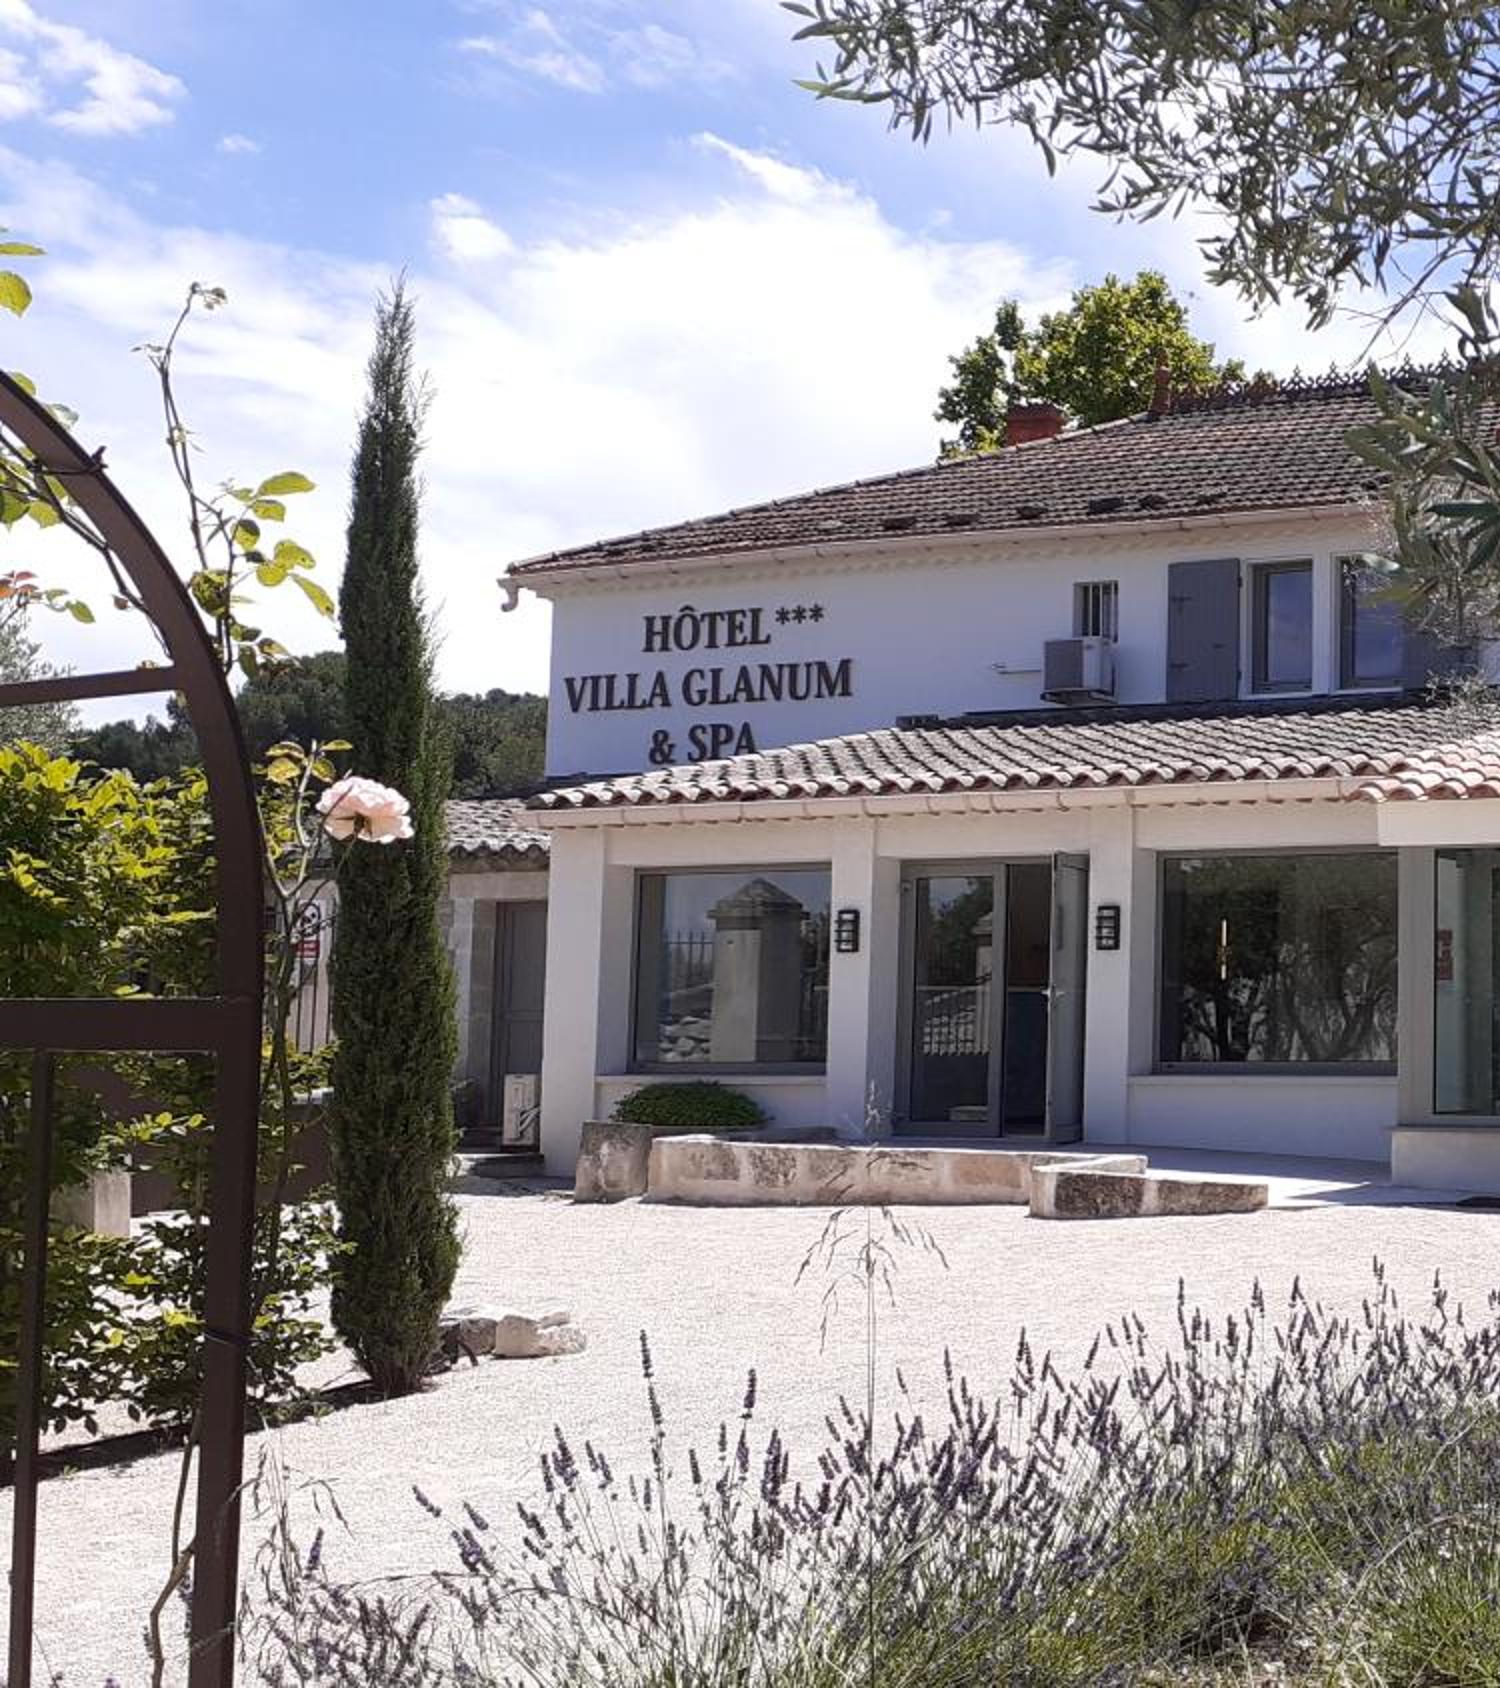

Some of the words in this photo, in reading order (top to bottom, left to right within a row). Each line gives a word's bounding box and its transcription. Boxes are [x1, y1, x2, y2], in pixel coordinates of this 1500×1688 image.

[642, 605, 771, 652] HÔTEL
[564, 670, 672, 713] VILLA
[682, 658, 854, 707] GLANUM
[648, 729, 676, 765] &
[687, 721, 757, 763] SPA
